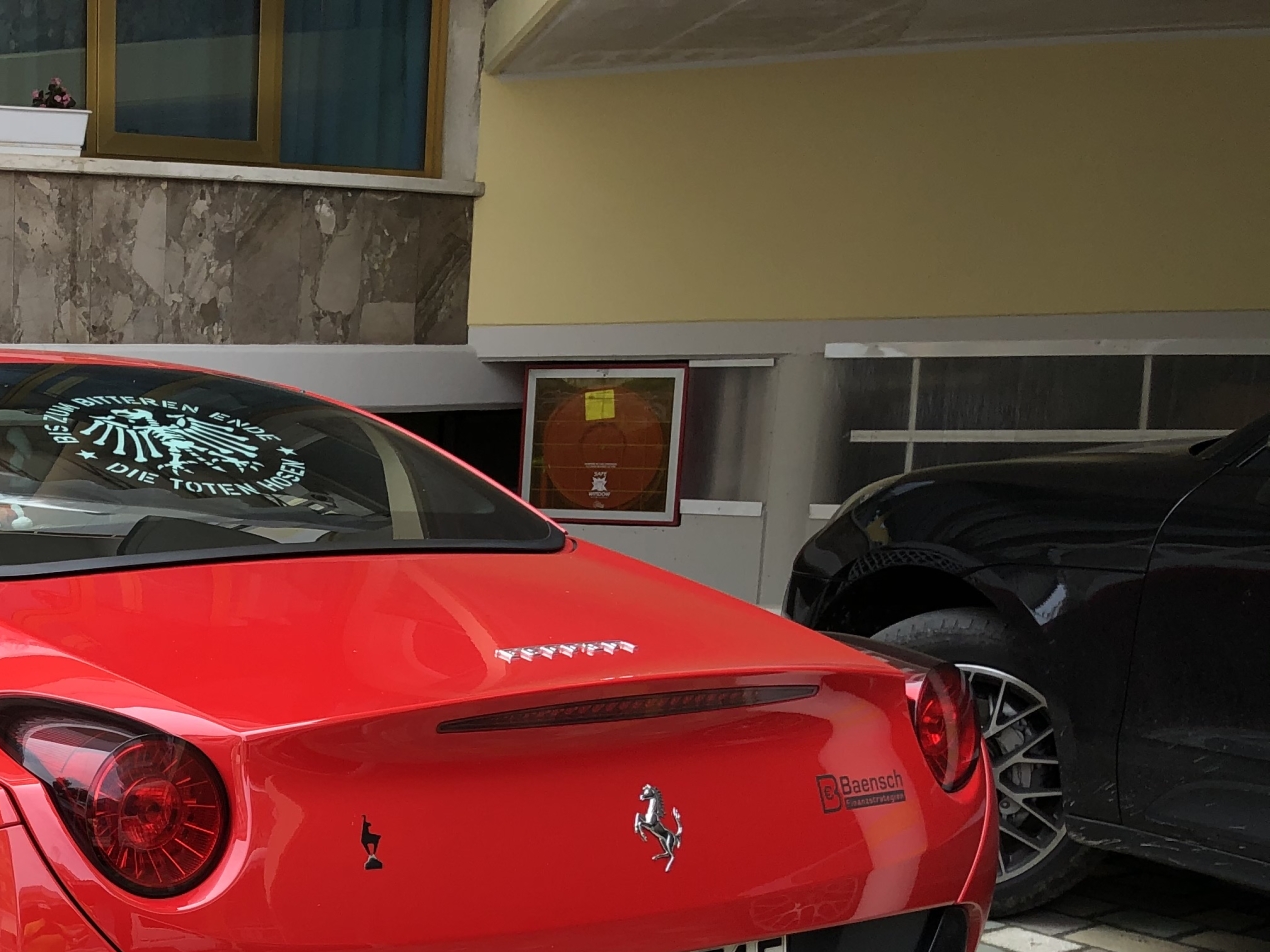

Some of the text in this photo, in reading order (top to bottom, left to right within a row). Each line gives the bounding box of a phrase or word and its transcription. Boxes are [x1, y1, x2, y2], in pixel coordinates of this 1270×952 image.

[42, 395, 282, 444] BIS ZUM BITTEREN ENDE
[105, 458, 306, 497] DIE TOTEN HOSEN
[839, 769, 903, 796] Baensch
